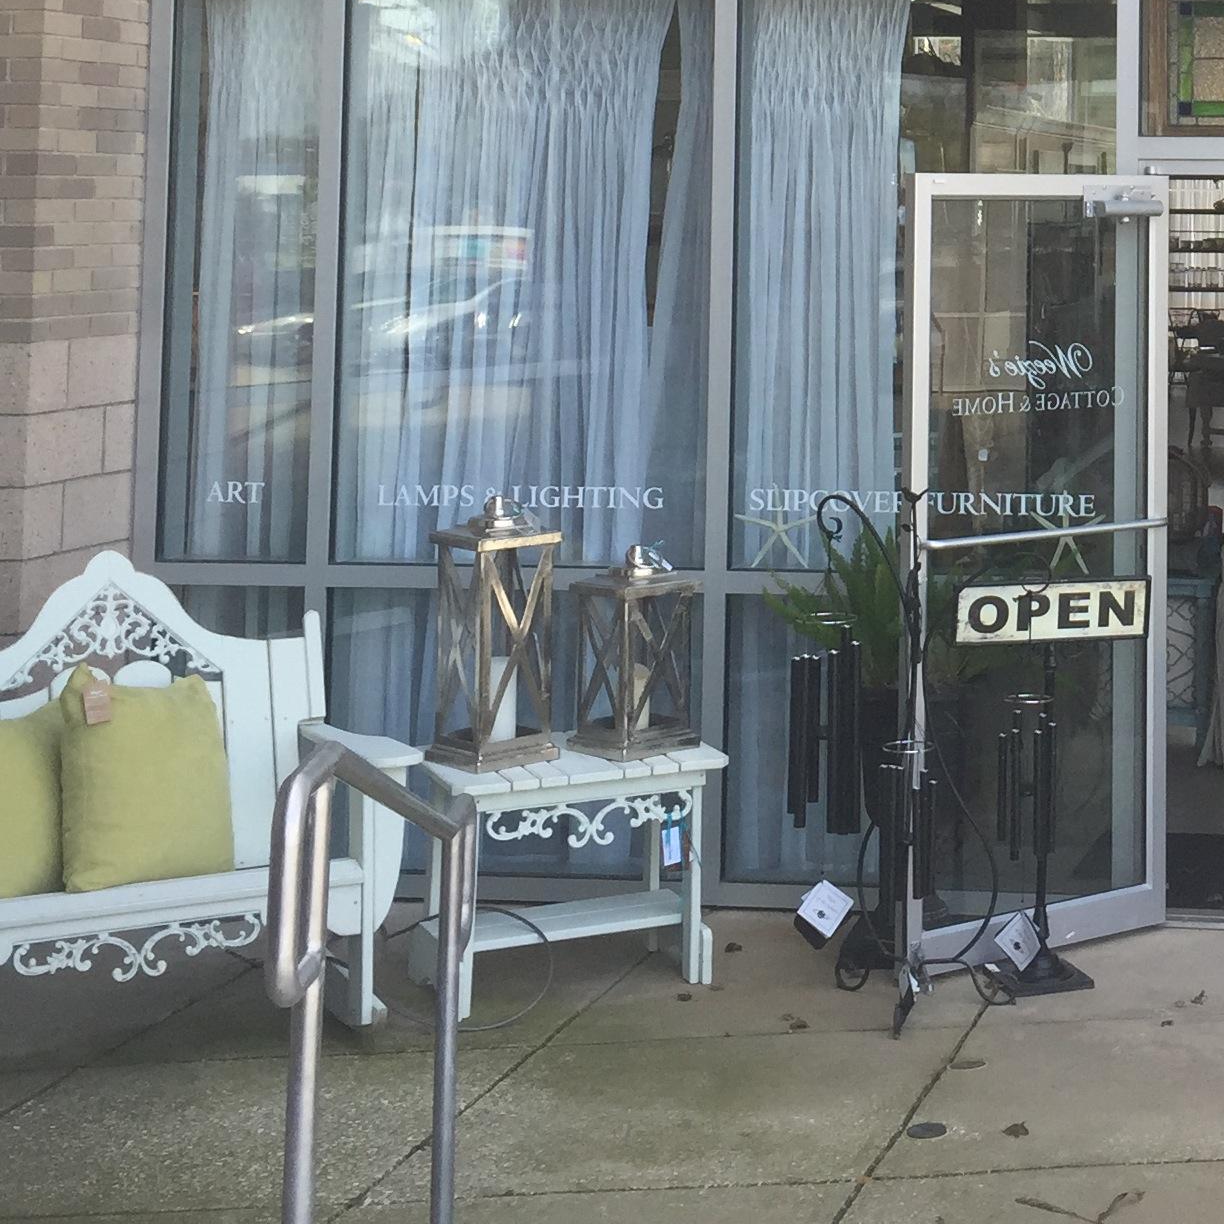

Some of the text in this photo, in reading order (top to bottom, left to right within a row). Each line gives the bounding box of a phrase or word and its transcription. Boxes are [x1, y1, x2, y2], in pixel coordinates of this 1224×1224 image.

[206, 481, 265, 505] ART
[377, 483, 475, 507] LAMPS
[512, 485, 664, 509] LIGHTING
[967, 590, 1135, 634] OPEN
